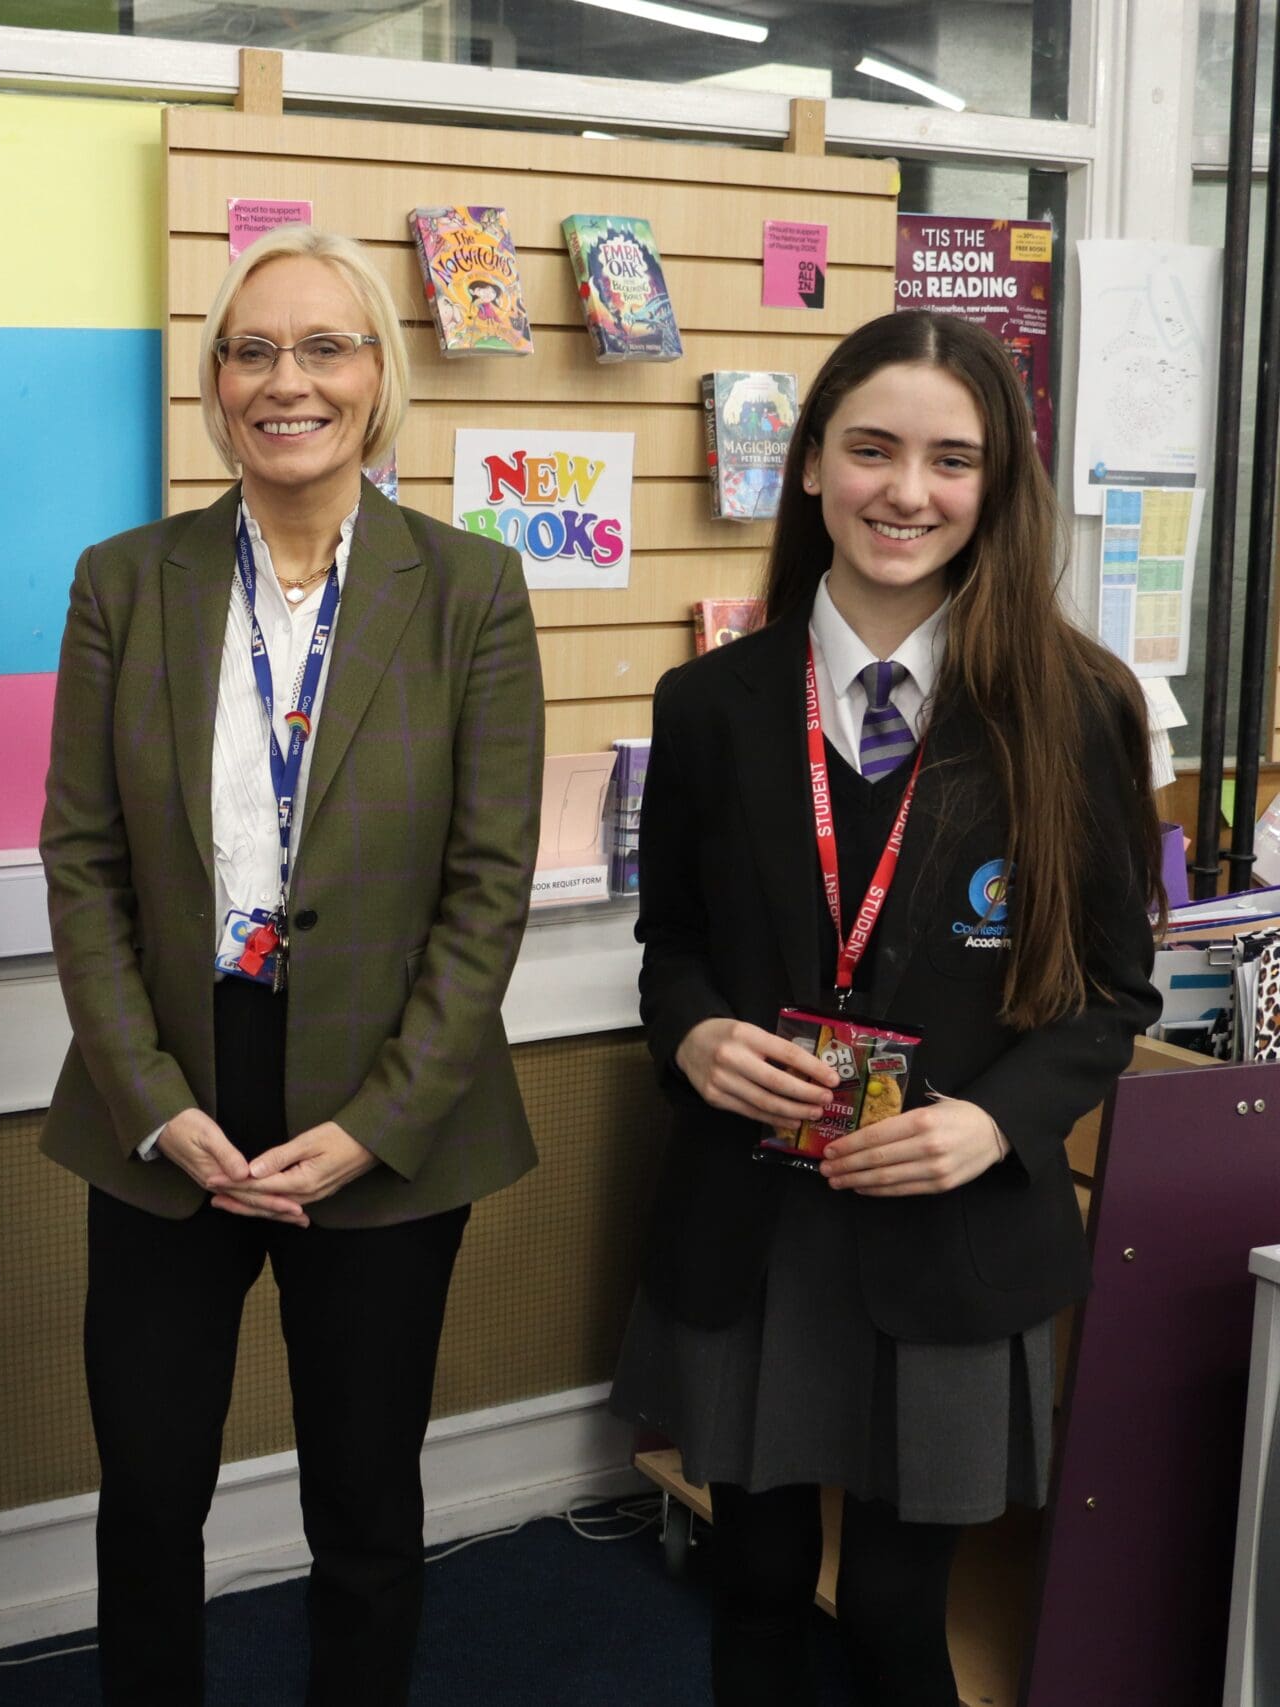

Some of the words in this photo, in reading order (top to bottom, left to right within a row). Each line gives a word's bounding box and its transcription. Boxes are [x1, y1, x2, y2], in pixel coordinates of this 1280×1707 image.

[234, 205, 259, 214] Proud
[270, 206, 301, 214] support
[236, 214, 249, 222] The
[250, 214, 282, 223] National
[452, 230, 476, 246] The
[921, 228, 951, 247] 'TIS
[954, 229, 985, 248] THE
[602, 244, 642, 266] EMBA
[912, 250, 995, 273] SEASON
[608, 260, 643, 278] OAK
[798, 261, 814, 272] GO
[798, 272, 814, 282] ALL
[926, 276, 1018, 298] READING
[723, 440, 788, 456] MAGICBOR
[484, 450, 606, 504] NEW
[462, 508, 624, 564] BOOKS
[310, 624, 330, 656] LIFE
[810, 762, 832, 838] STUDENT
[552, 879, 581, 888] REQUEST
[582, 876, 602, 885] FORM
[845, 885, 884, 964] STUDENT
[821, 1048, 853, 1067] OH
[824, 1103, 854, 1116] OTTED
